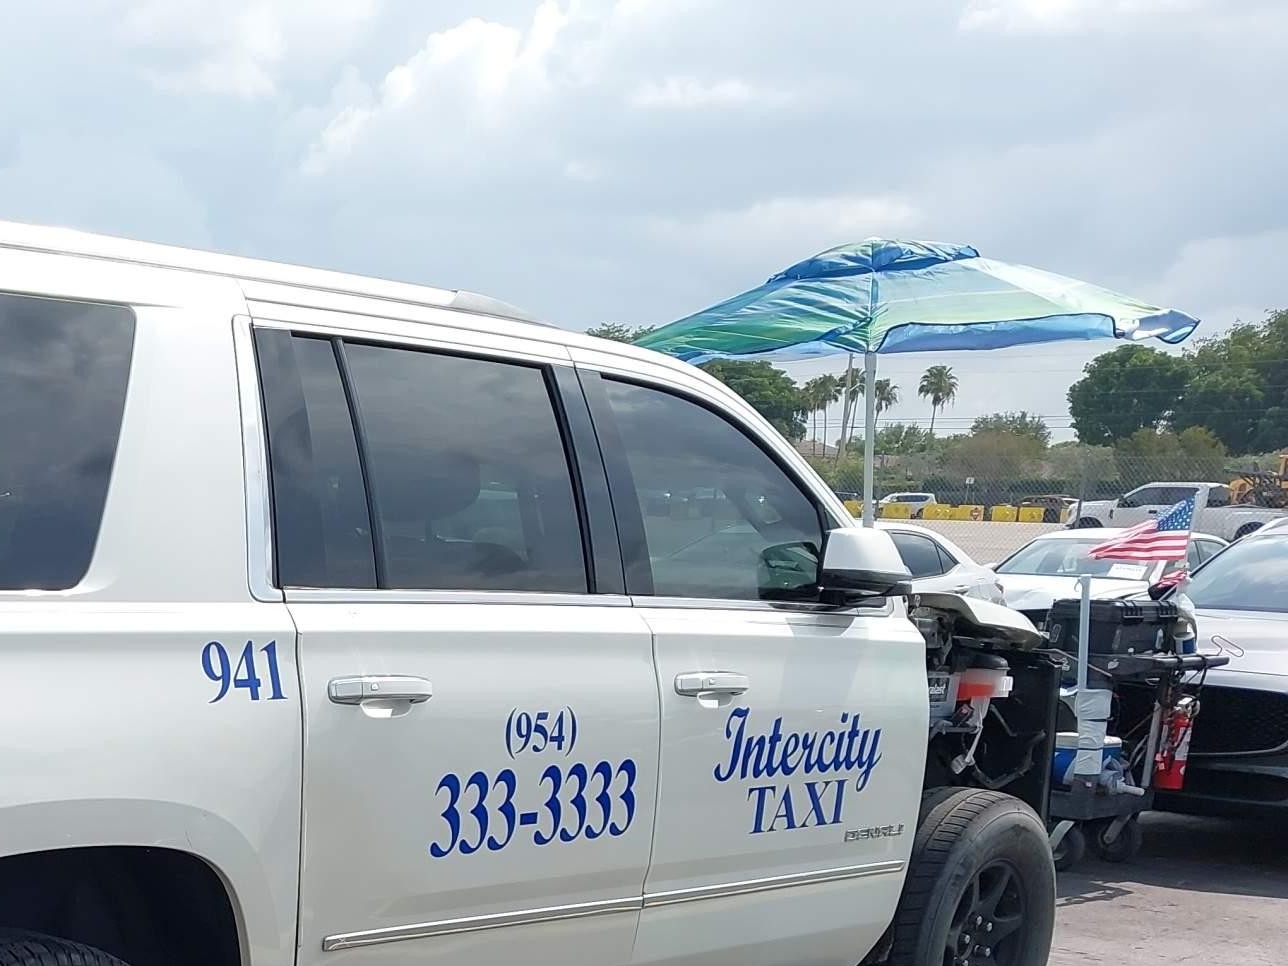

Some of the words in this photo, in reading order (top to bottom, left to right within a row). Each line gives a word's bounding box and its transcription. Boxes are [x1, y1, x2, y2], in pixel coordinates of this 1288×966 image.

[201, 640, 285, 702] 941
[505, 706, 578, 760] (954)
[714, 707, 881, 793] Intercity
[429, 758, 638, 859] 333-3333
[747, 778, 846, 835] TAXI
